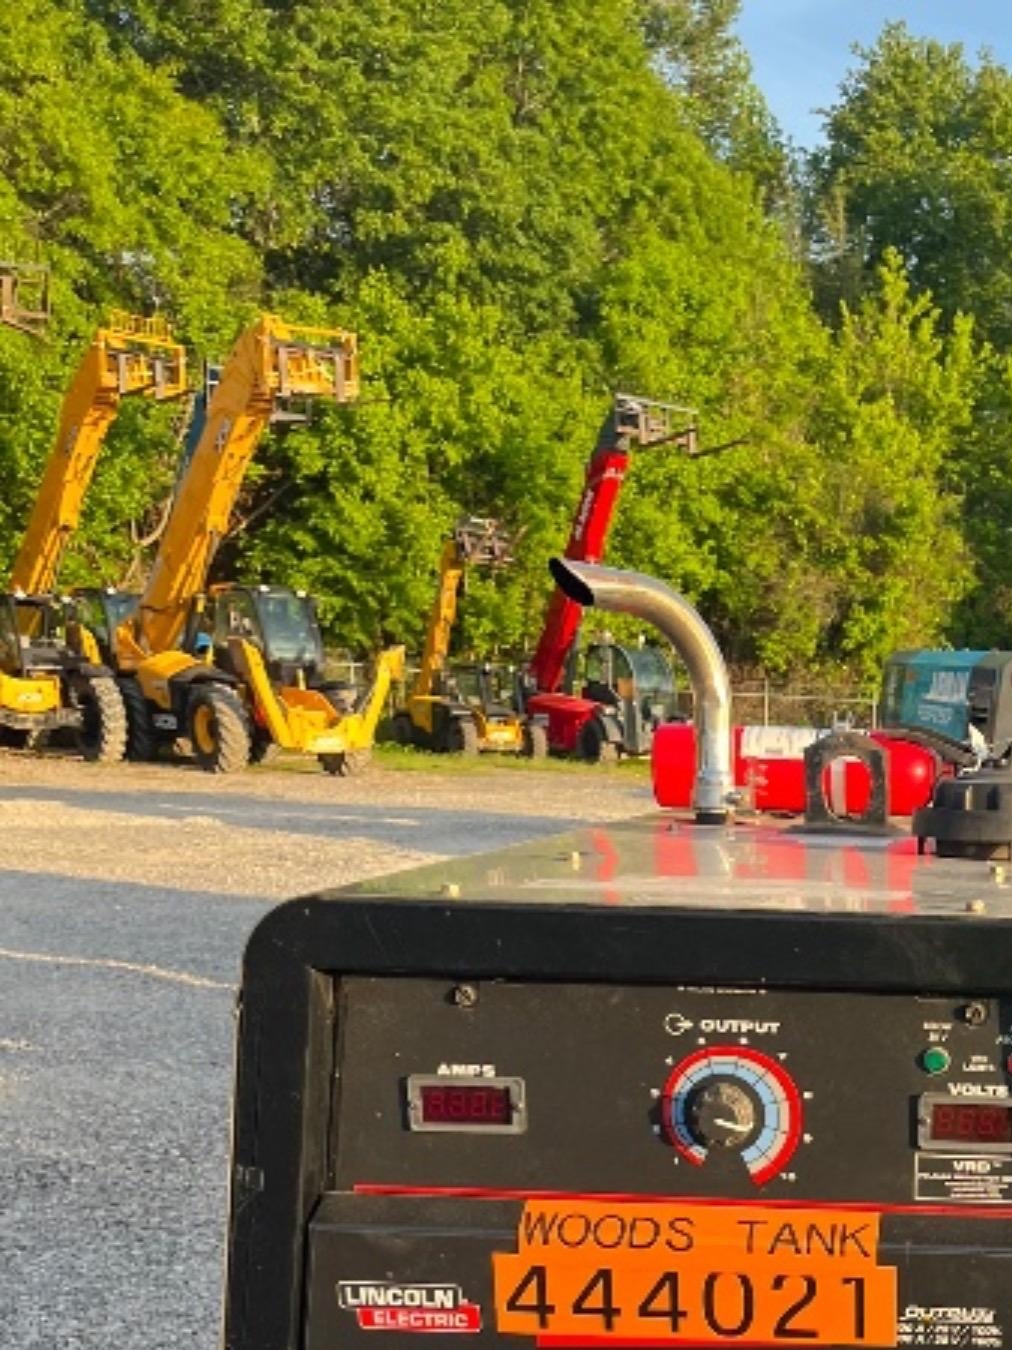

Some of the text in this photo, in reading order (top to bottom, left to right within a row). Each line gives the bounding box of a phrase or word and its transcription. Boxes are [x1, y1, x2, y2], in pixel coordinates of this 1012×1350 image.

[699, 1019, 780, 1034] OUTPUT
[947, 1082, 1009, 1098] VOLTS
[520, 1211, 872, 1257] WOODS TANK
[343, 1285, 454, 1308] LINCOLN
[506, 1264, 868, 1340] 444021
[372, 1310, 470, 1328] ELECTRIC
